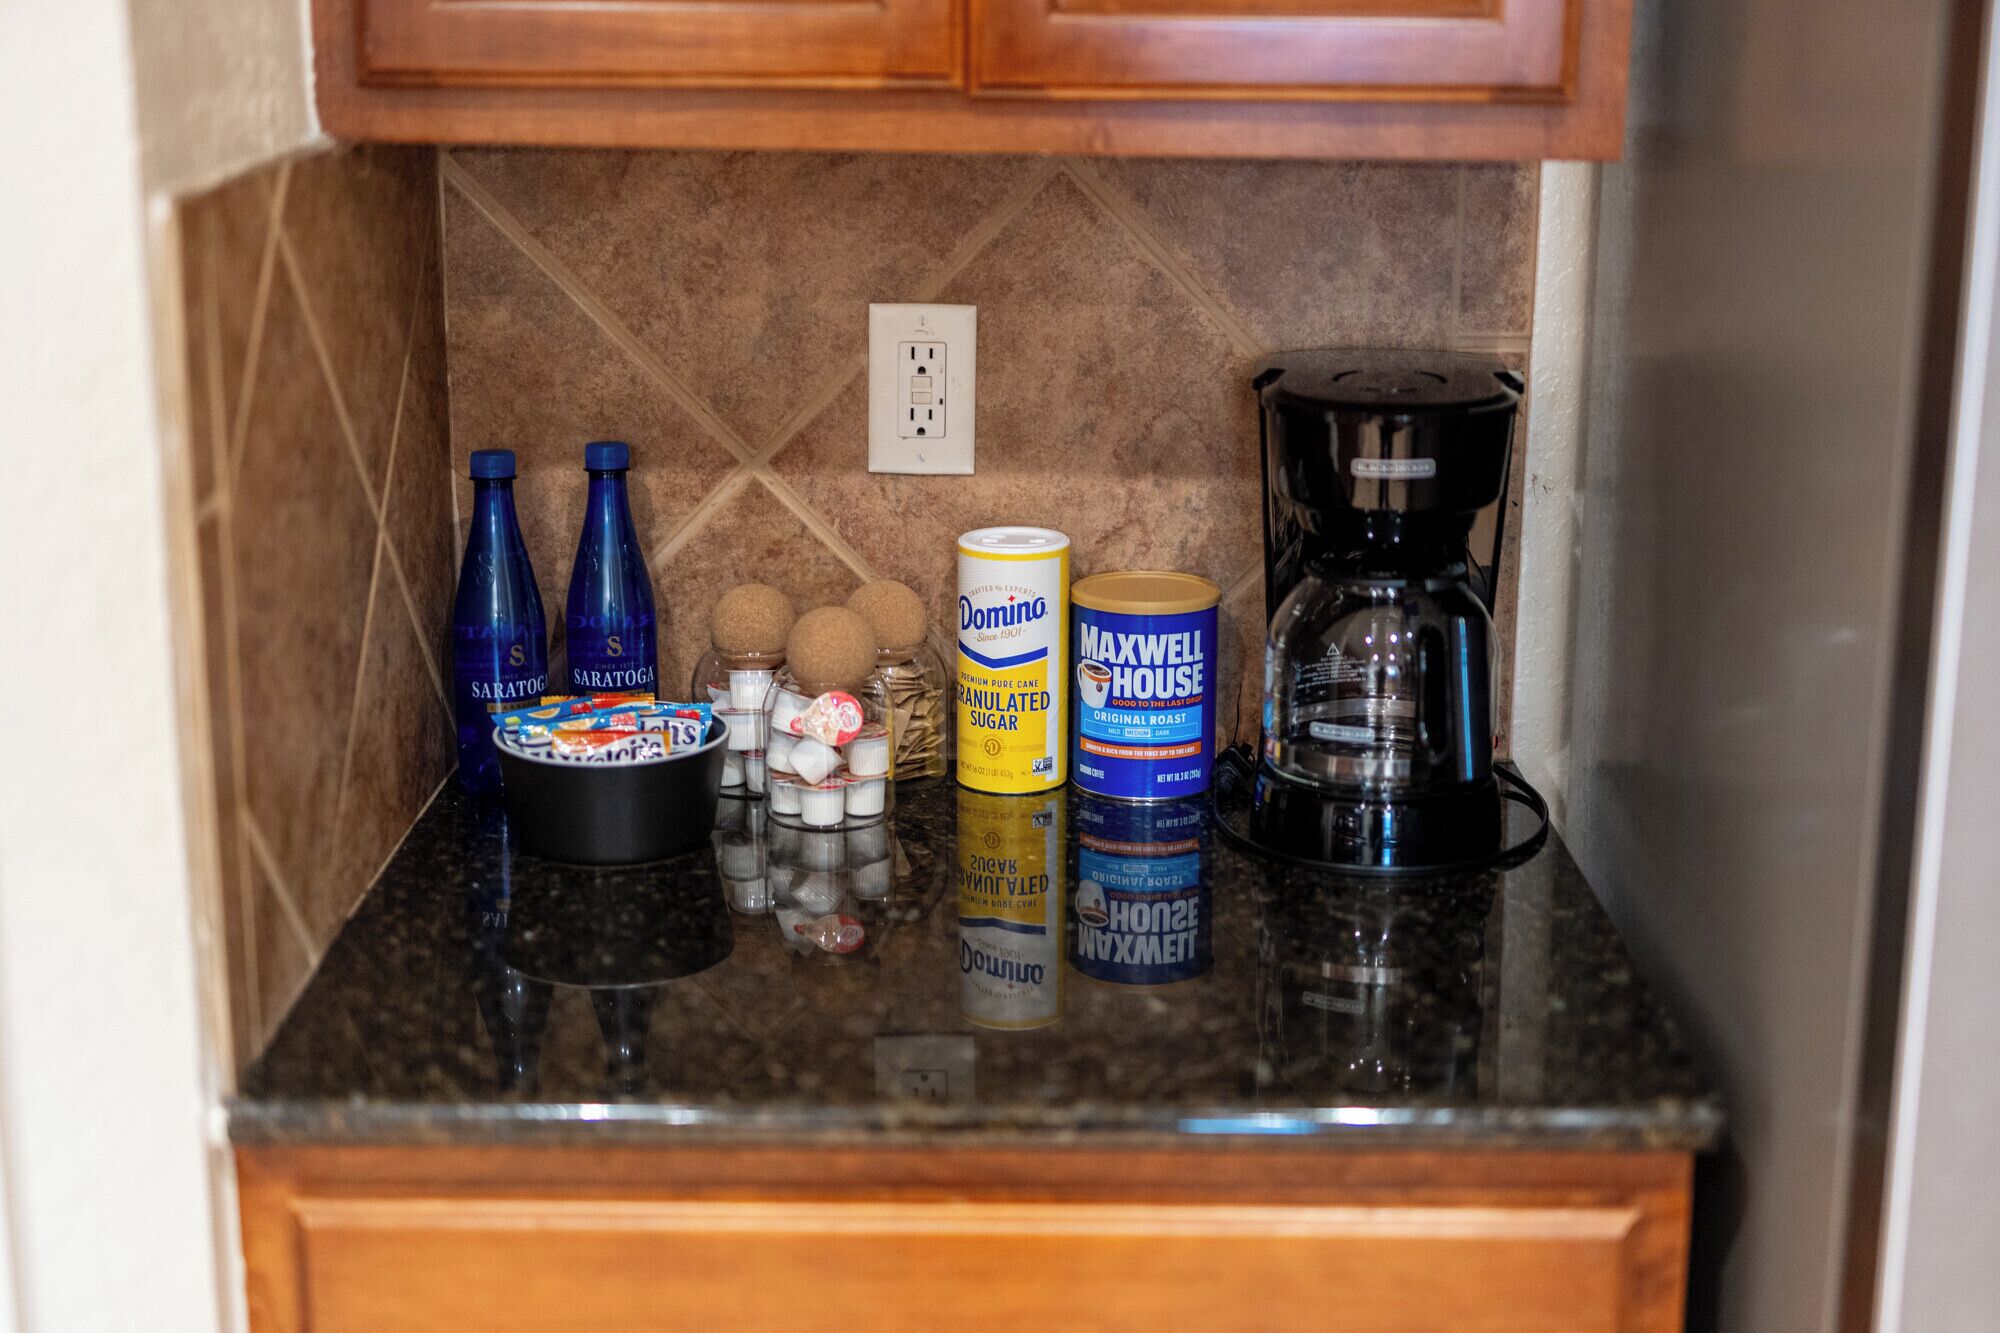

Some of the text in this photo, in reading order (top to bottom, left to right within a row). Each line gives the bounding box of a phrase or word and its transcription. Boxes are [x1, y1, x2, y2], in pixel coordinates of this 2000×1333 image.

[969, 585, 993, 597] CRAFTED
[1005, 585, 1036, 598] EXPERTS
[959, 594, 1046, 631] Domino
[607, 636, 623, 657] S
[1081, 622, 1203, 666] MAXWELL
[509, 645, 525, 667] S
[574, 666, 654, 687] SARATOGA
[961, 672, 1039, 689] PREMIUM PURE CANE
[1113, 662, 1203, 700] HOUSE
[1112, 699, 1136, 707] GOOD
[1167, 699, 1184, 707] LAST
[970, 710, 1018, 730] SUGAR
[1094, 710, 1186, 725] ORIGINAL ROAST
